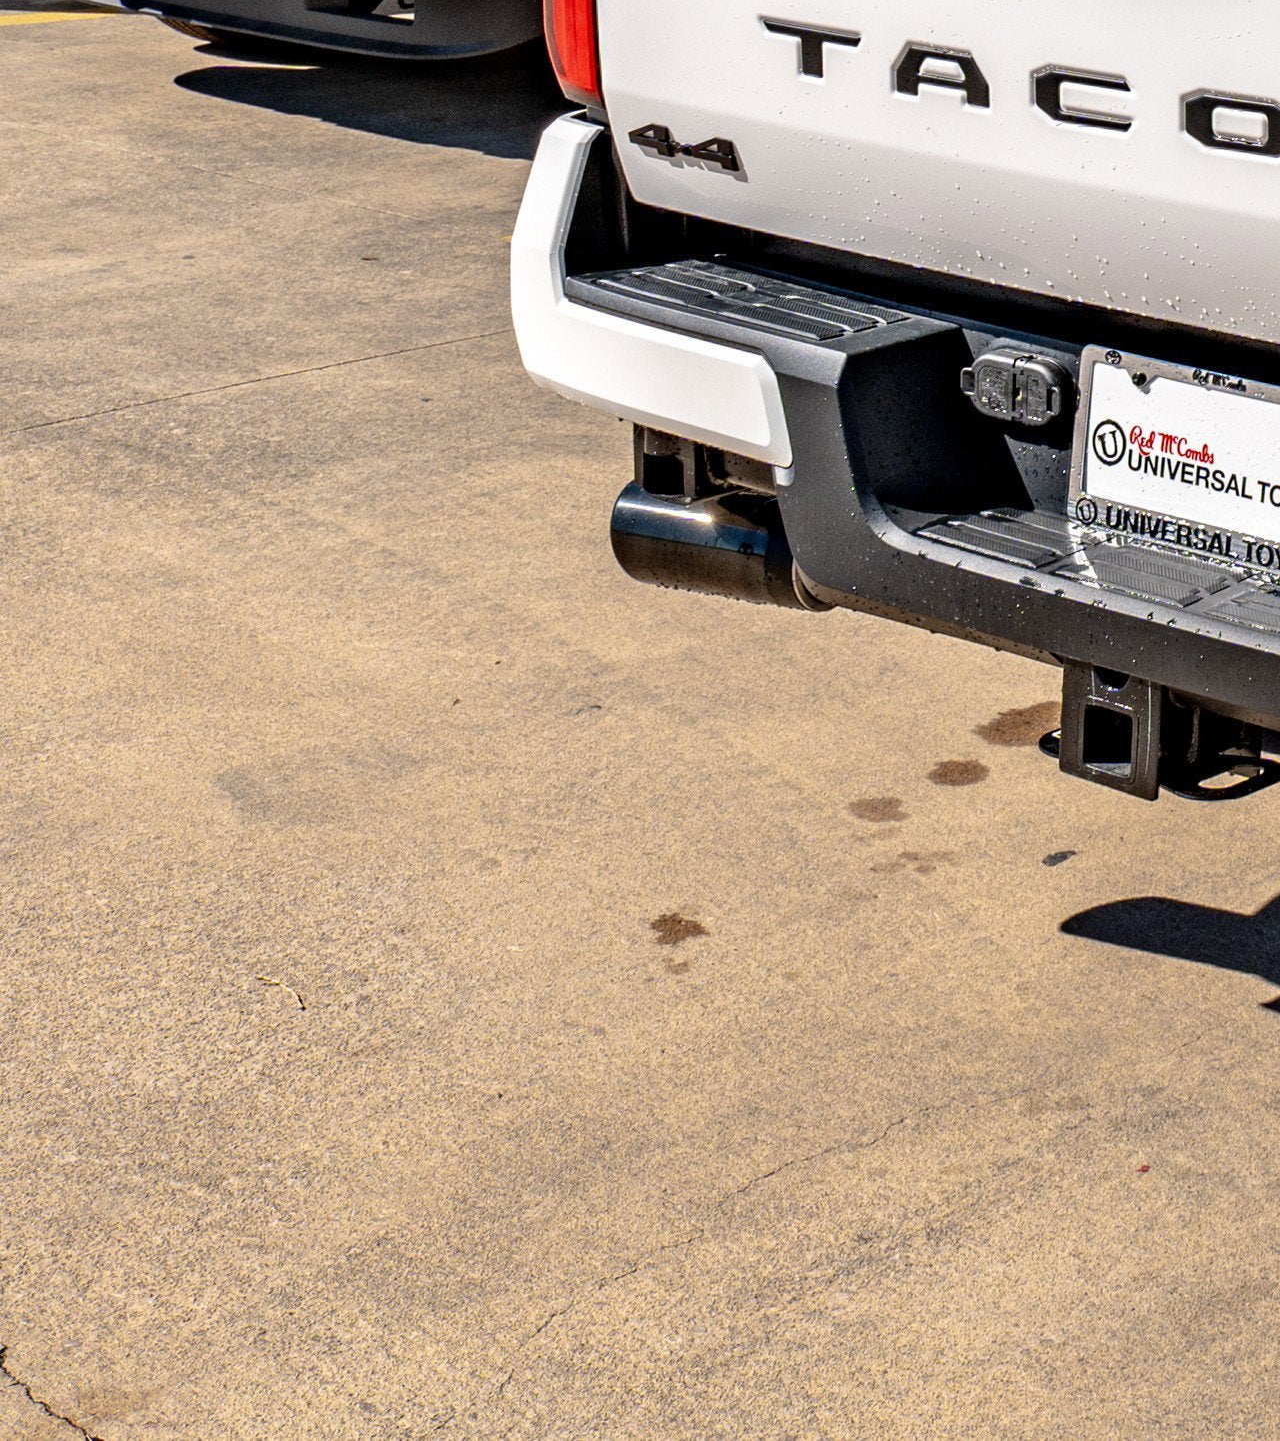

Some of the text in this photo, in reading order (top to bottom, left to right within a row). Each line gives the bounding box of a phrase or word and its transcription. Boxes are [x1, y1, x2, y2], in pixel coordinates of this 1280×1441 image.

[1129, 425, 1215, 465] Red McCombs
[1128, 448, 1252, 501] UNIVERSAL
[1105, 503, 1237, 559] UNIVERSAL
